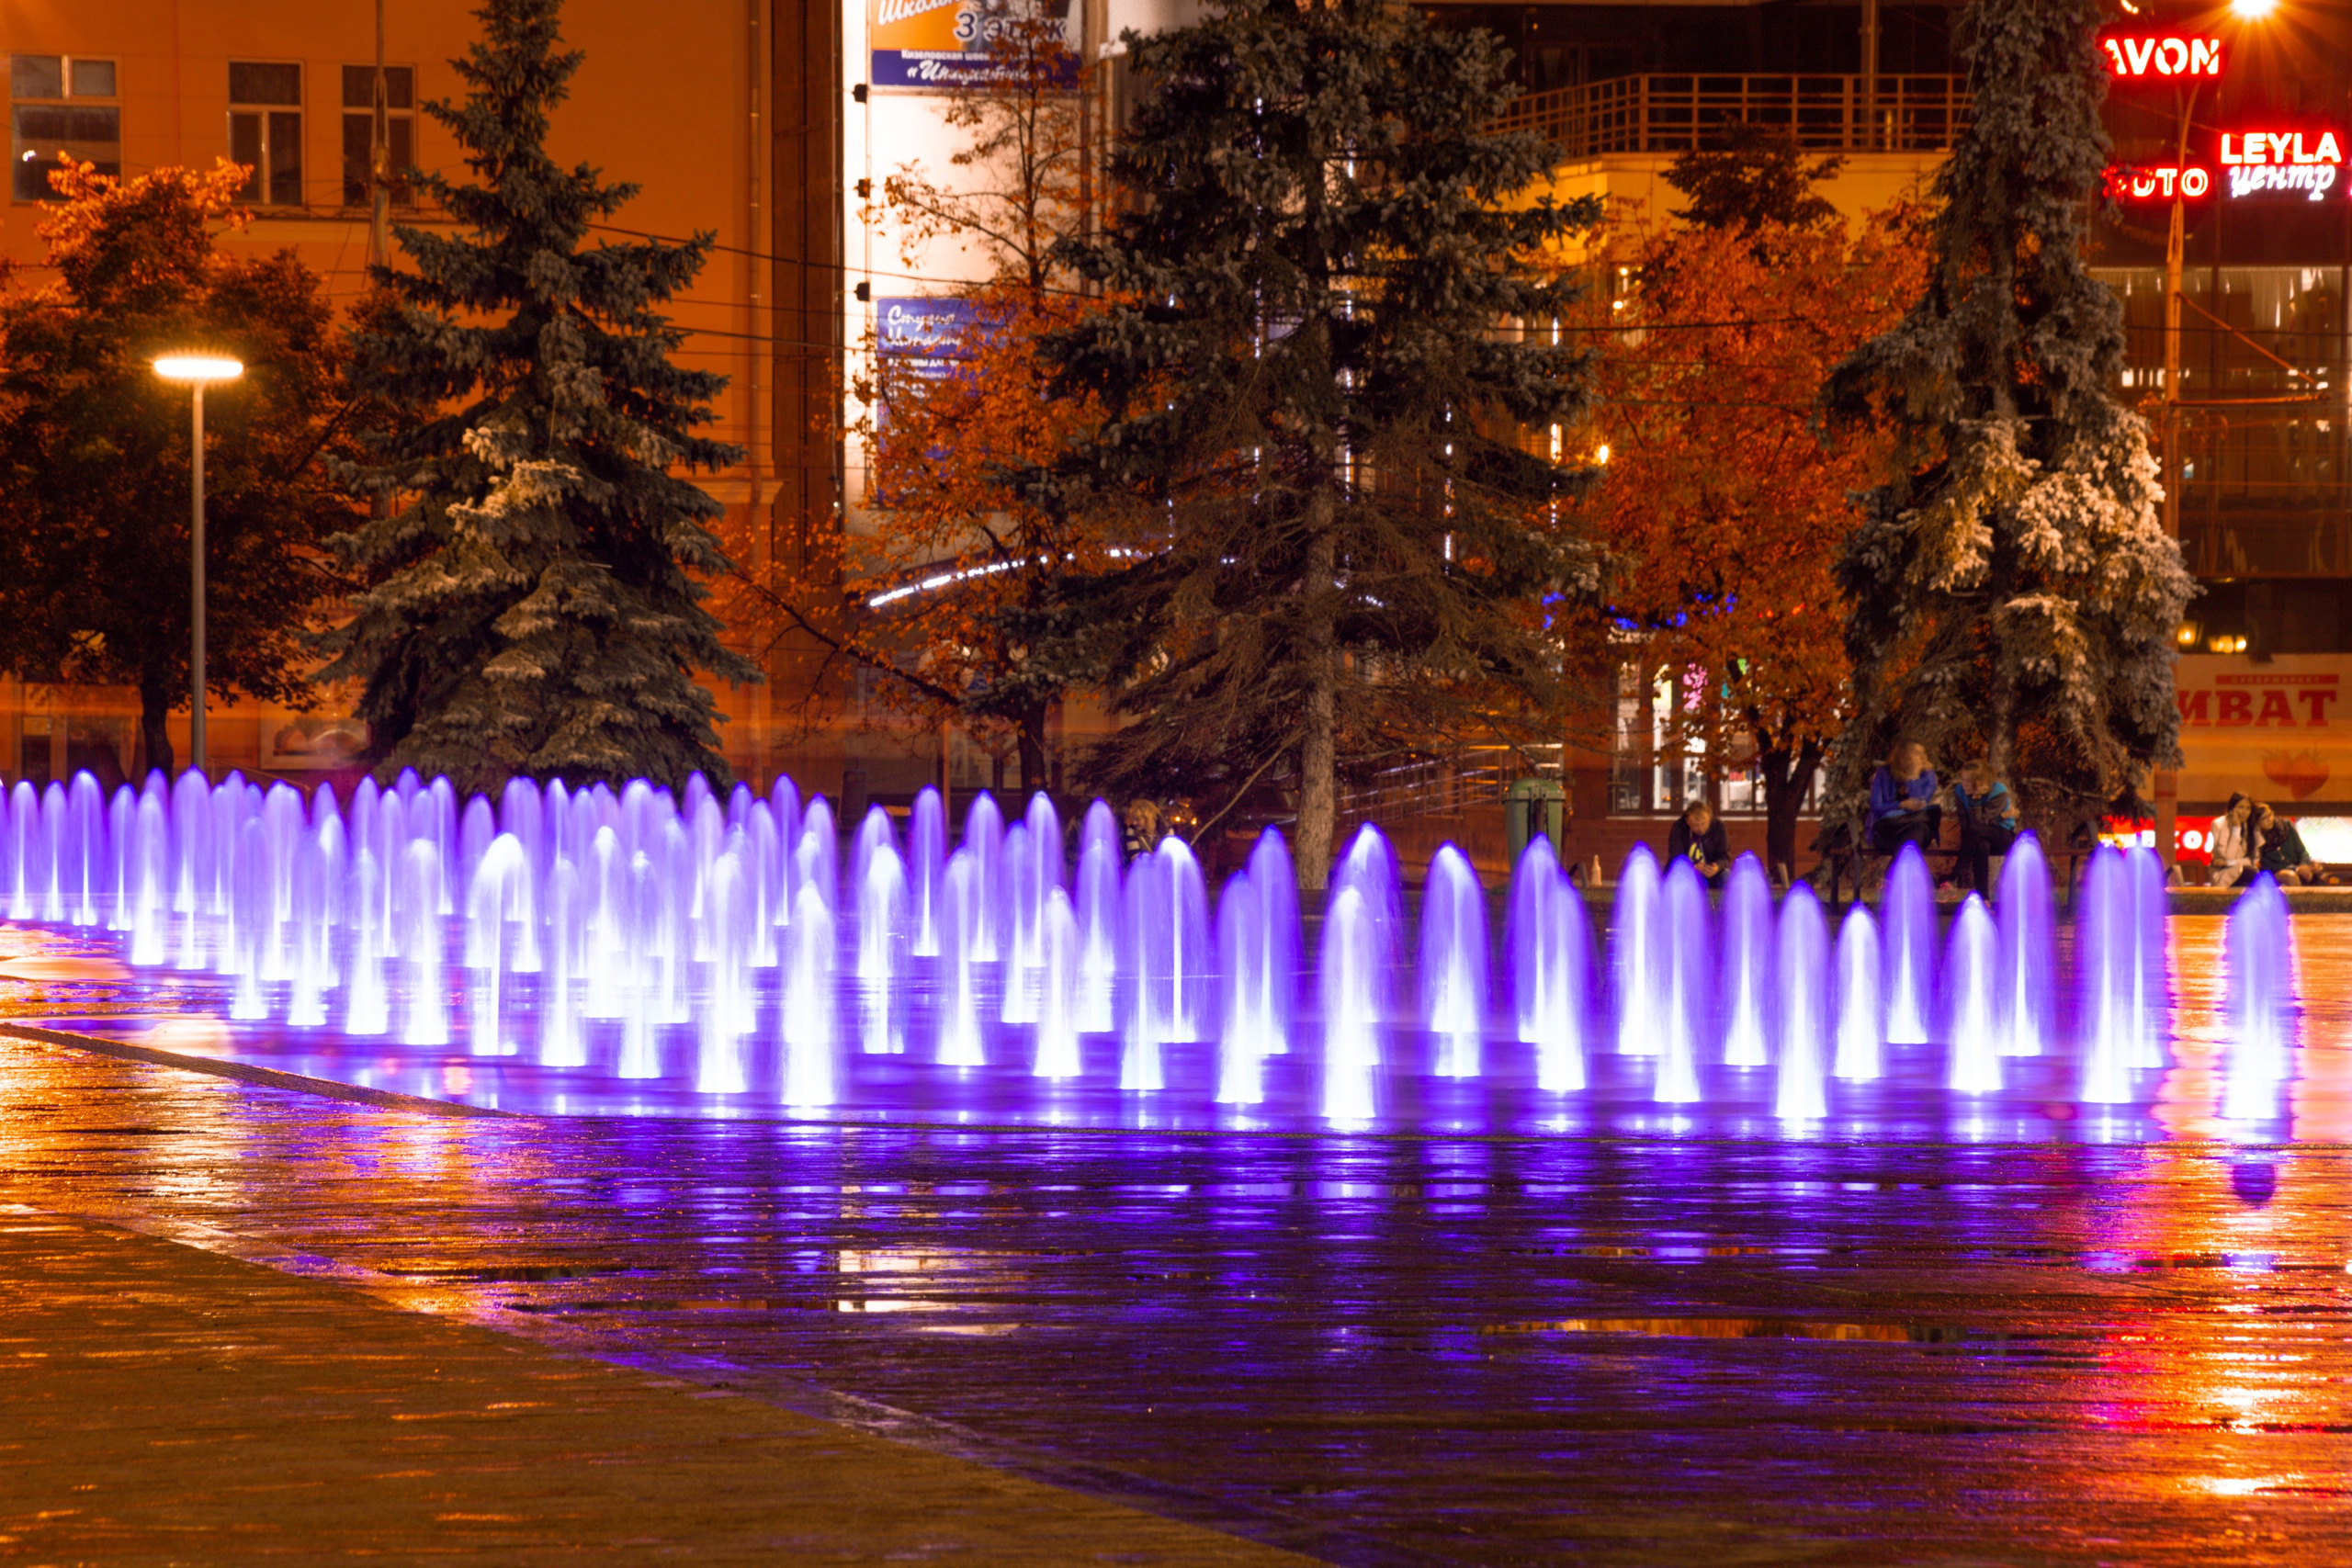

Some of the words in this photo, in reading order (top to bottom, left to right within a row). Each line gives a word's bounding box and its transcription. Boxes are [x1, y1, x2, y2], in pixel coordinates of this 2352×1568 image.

[2104, 38, 2220, 75] AVON
[2221, 132, 2342, 164] LEYLA
[2101, 166, 2209, 197] ОТО
[2229, 164, 2336, 201] центр
